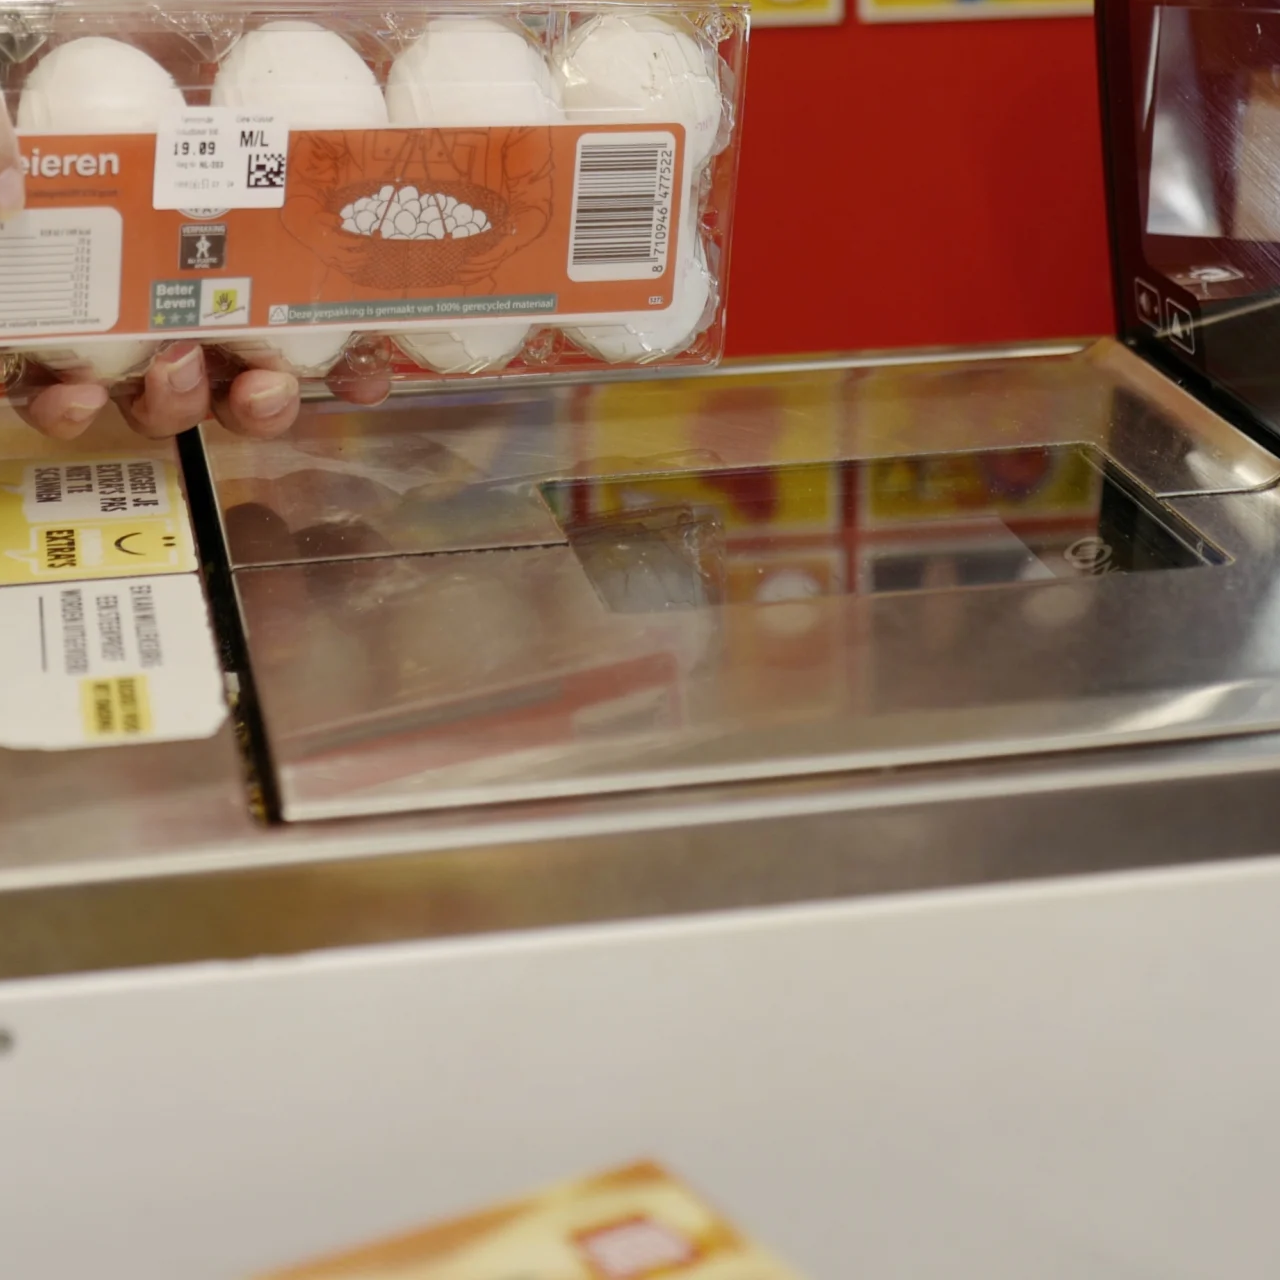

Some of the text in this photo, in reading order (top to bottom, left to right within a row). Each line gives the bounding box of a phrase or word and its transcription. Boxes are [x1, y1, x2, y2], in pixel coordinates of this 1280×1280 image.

[240, 130, 269, 147] M/L
[174, 142, 216, 155] 19.09
[652, 149, 673, 273] 8 710946 477522
[156, 284, 195, 296] Beter
[156, 297, 196, 309] Leven
[289, 299, 554, 320] Deze verpakking is gemaakt van 100% gerecycled materiaal
[35, 467, 62, 503] SCANNEN
[67, 483, 93, 494] TE
[127, 462, 159, 507] VERGEET JE
[100, 496, 127, 512] PAS
[46, 529, 76, 569] EXTRA'S
